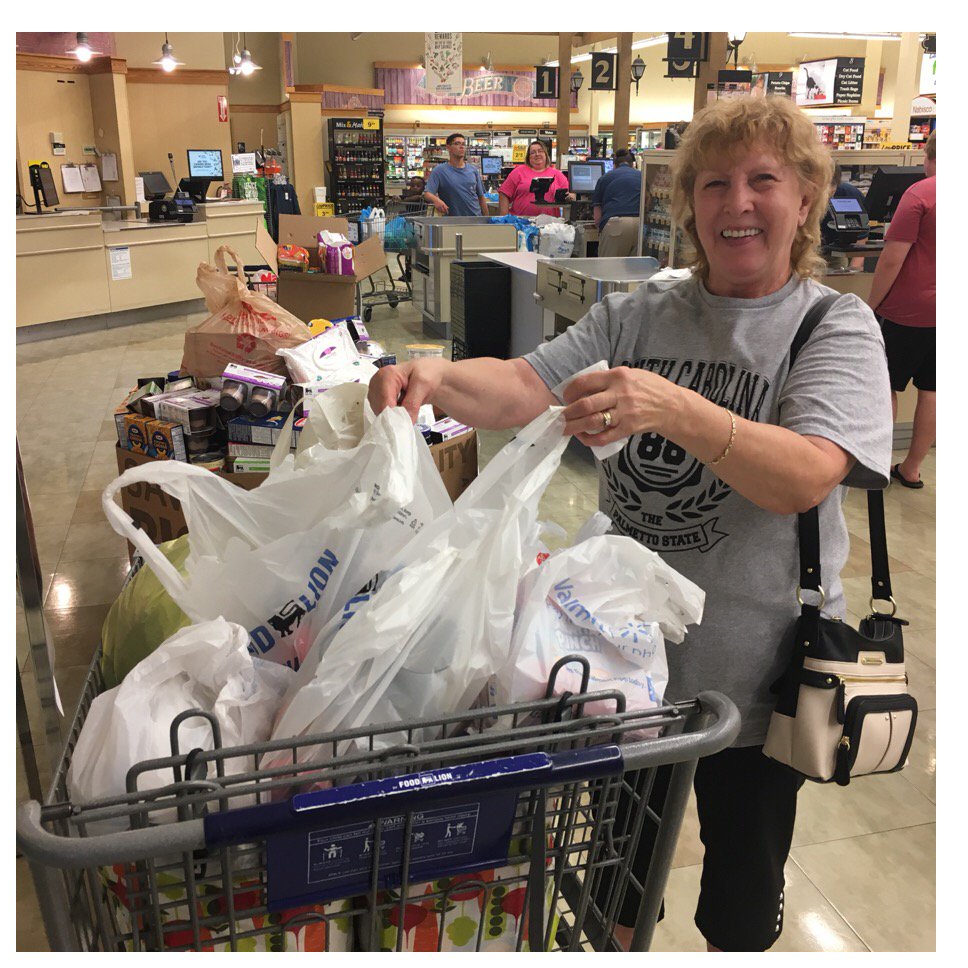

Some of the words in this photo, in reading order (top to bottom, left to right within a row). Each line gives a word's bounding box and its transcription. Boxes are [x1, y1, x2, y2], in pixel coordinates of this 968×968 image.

[540, 71, 552, 94] 1
[595, 60, 609, 83] 2
[461, 77, 503, 100] BEER
[913, 106, 933, 114] Nabisco
[612, 512, 659, 546] PALMETTO
[662, 531, 701, 547] STATE
[641, 512, 663, 526] THE
[399, 779, 420, 788] FOOD
[435, 773, 453, 782] LION
